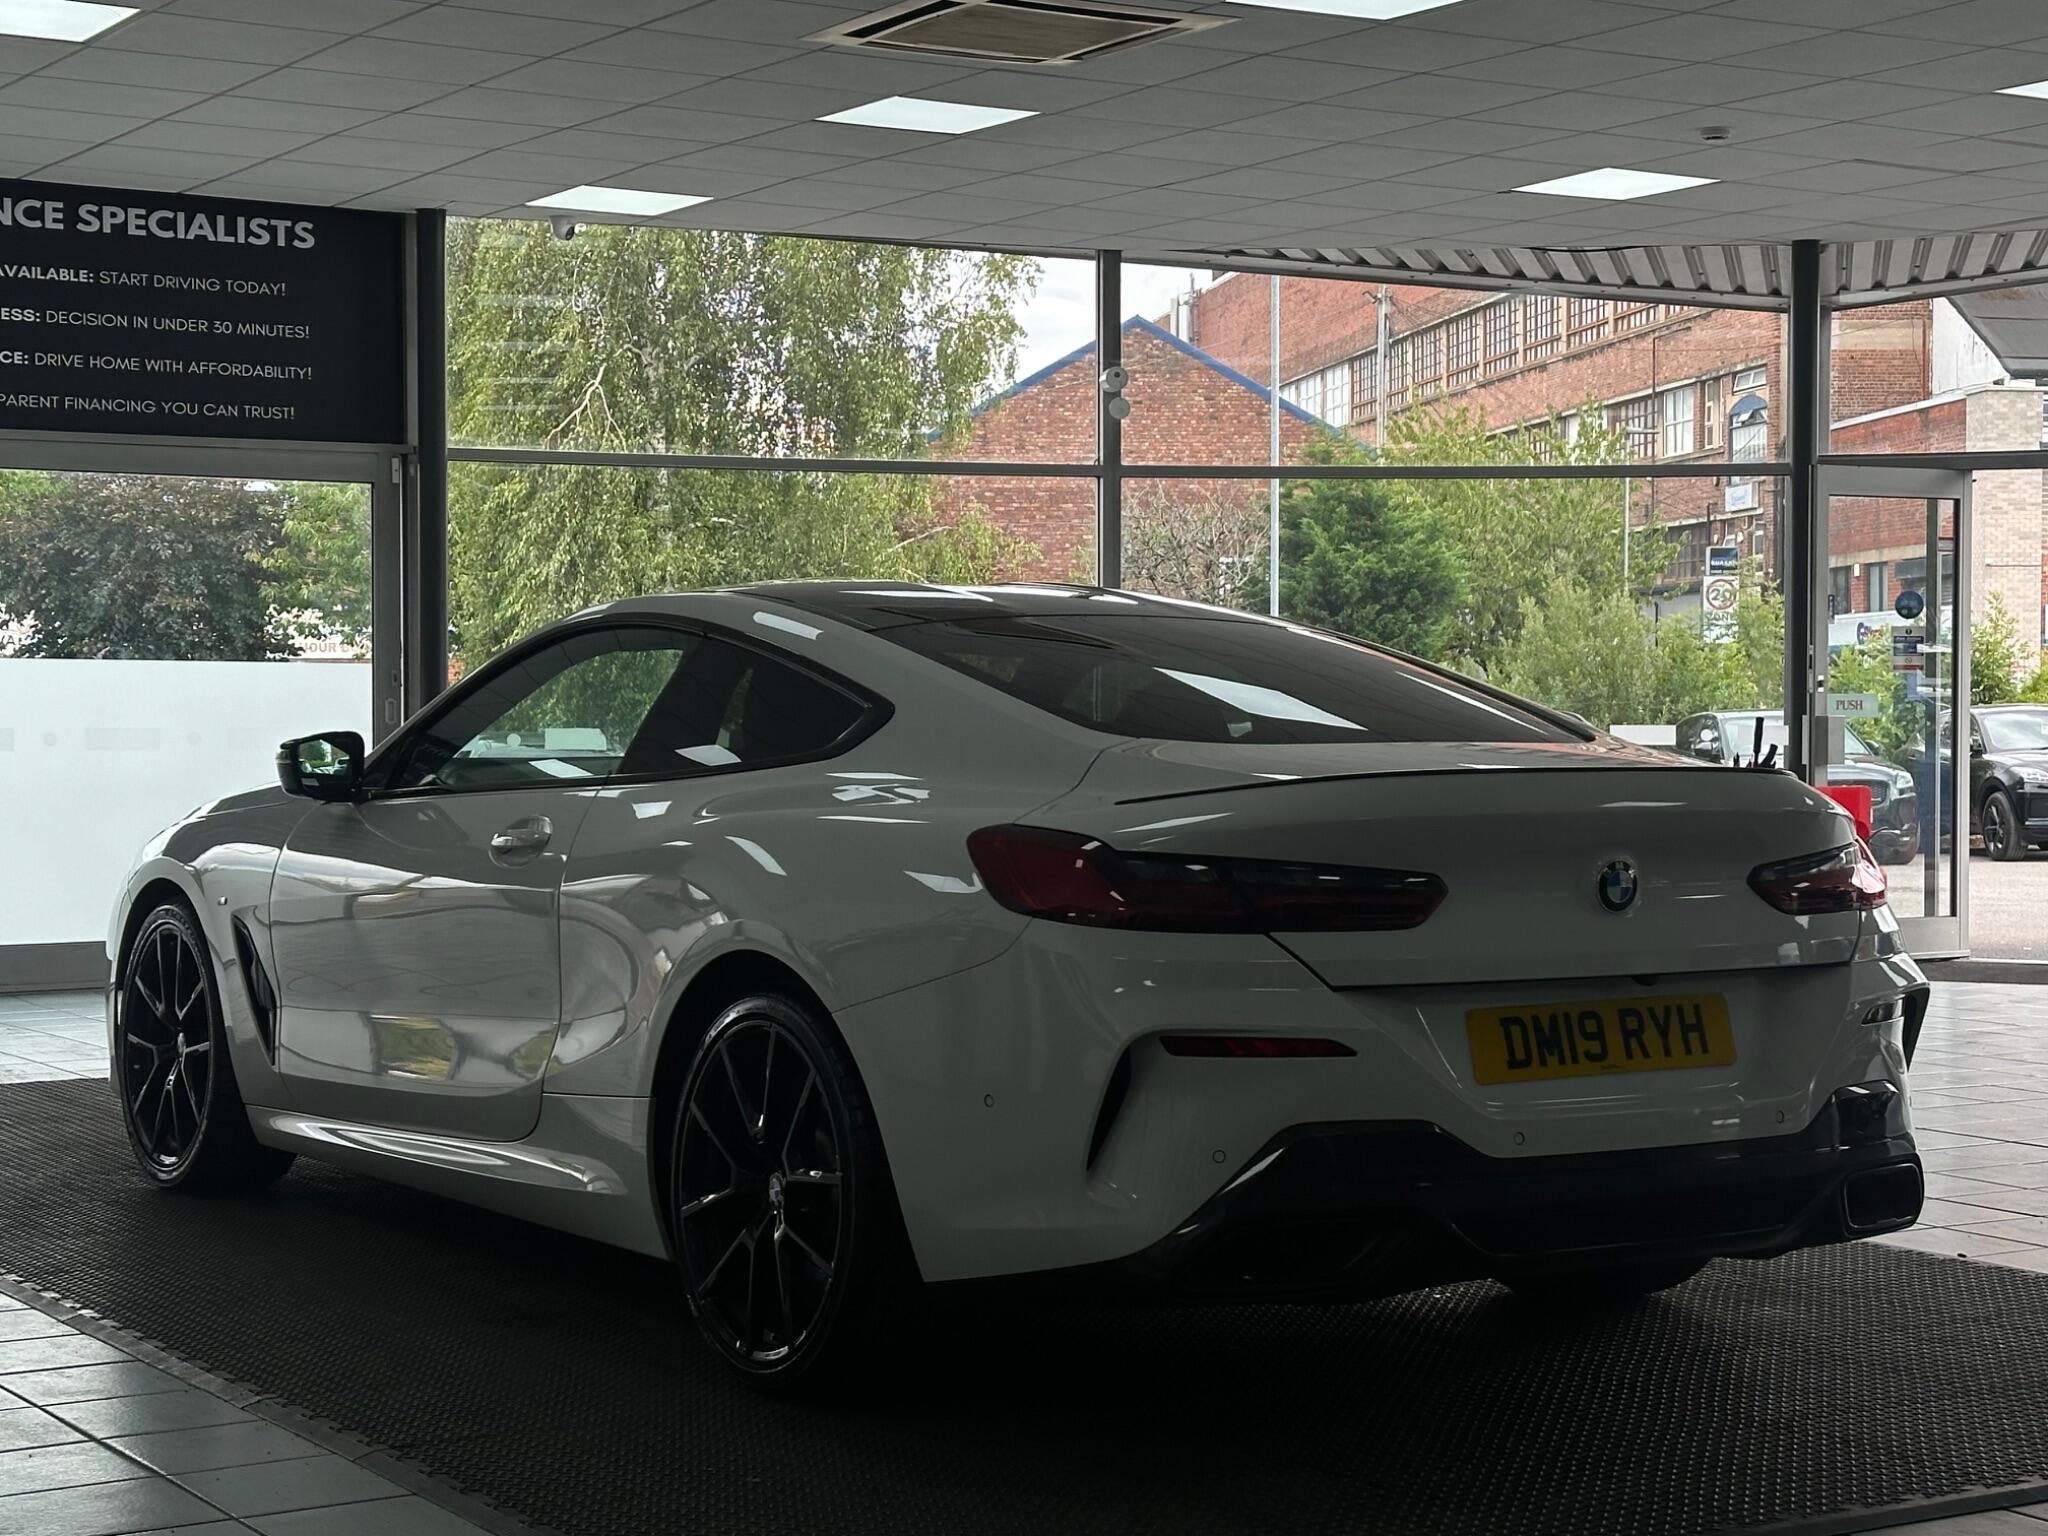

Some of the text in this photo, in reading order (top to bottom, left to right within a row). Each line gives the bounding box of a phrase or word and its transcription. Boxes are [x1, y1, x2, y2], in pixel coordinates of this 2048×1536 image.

[76, 203, 316, 249] SPECIALISTS
[99, 271, 148, 286] START
[153, 275, 221, 292] DRIVING
[225, 280, 286, 297] TODAY!
[0, 308, 310, 339] ESS: DECISION IN UNDER 30 MINUTES!
[34, 353, 84, 368] DRIVE
[89, 356, 140, 371] HOME
[144, 359, 183, 373] WITH
[188, 361, 312, 380] AFFORDABILITY!
[64, 397, 156, 413] FINANCING
[161, 402, 198, 416] YOU
[203, 404, 238, 417] CAN
[244, 406, 295, 420] TRUST!
[1836, 700, 1863, 711] PUSH
[1499, 1004, 1709, 1070] DM19 RYH
